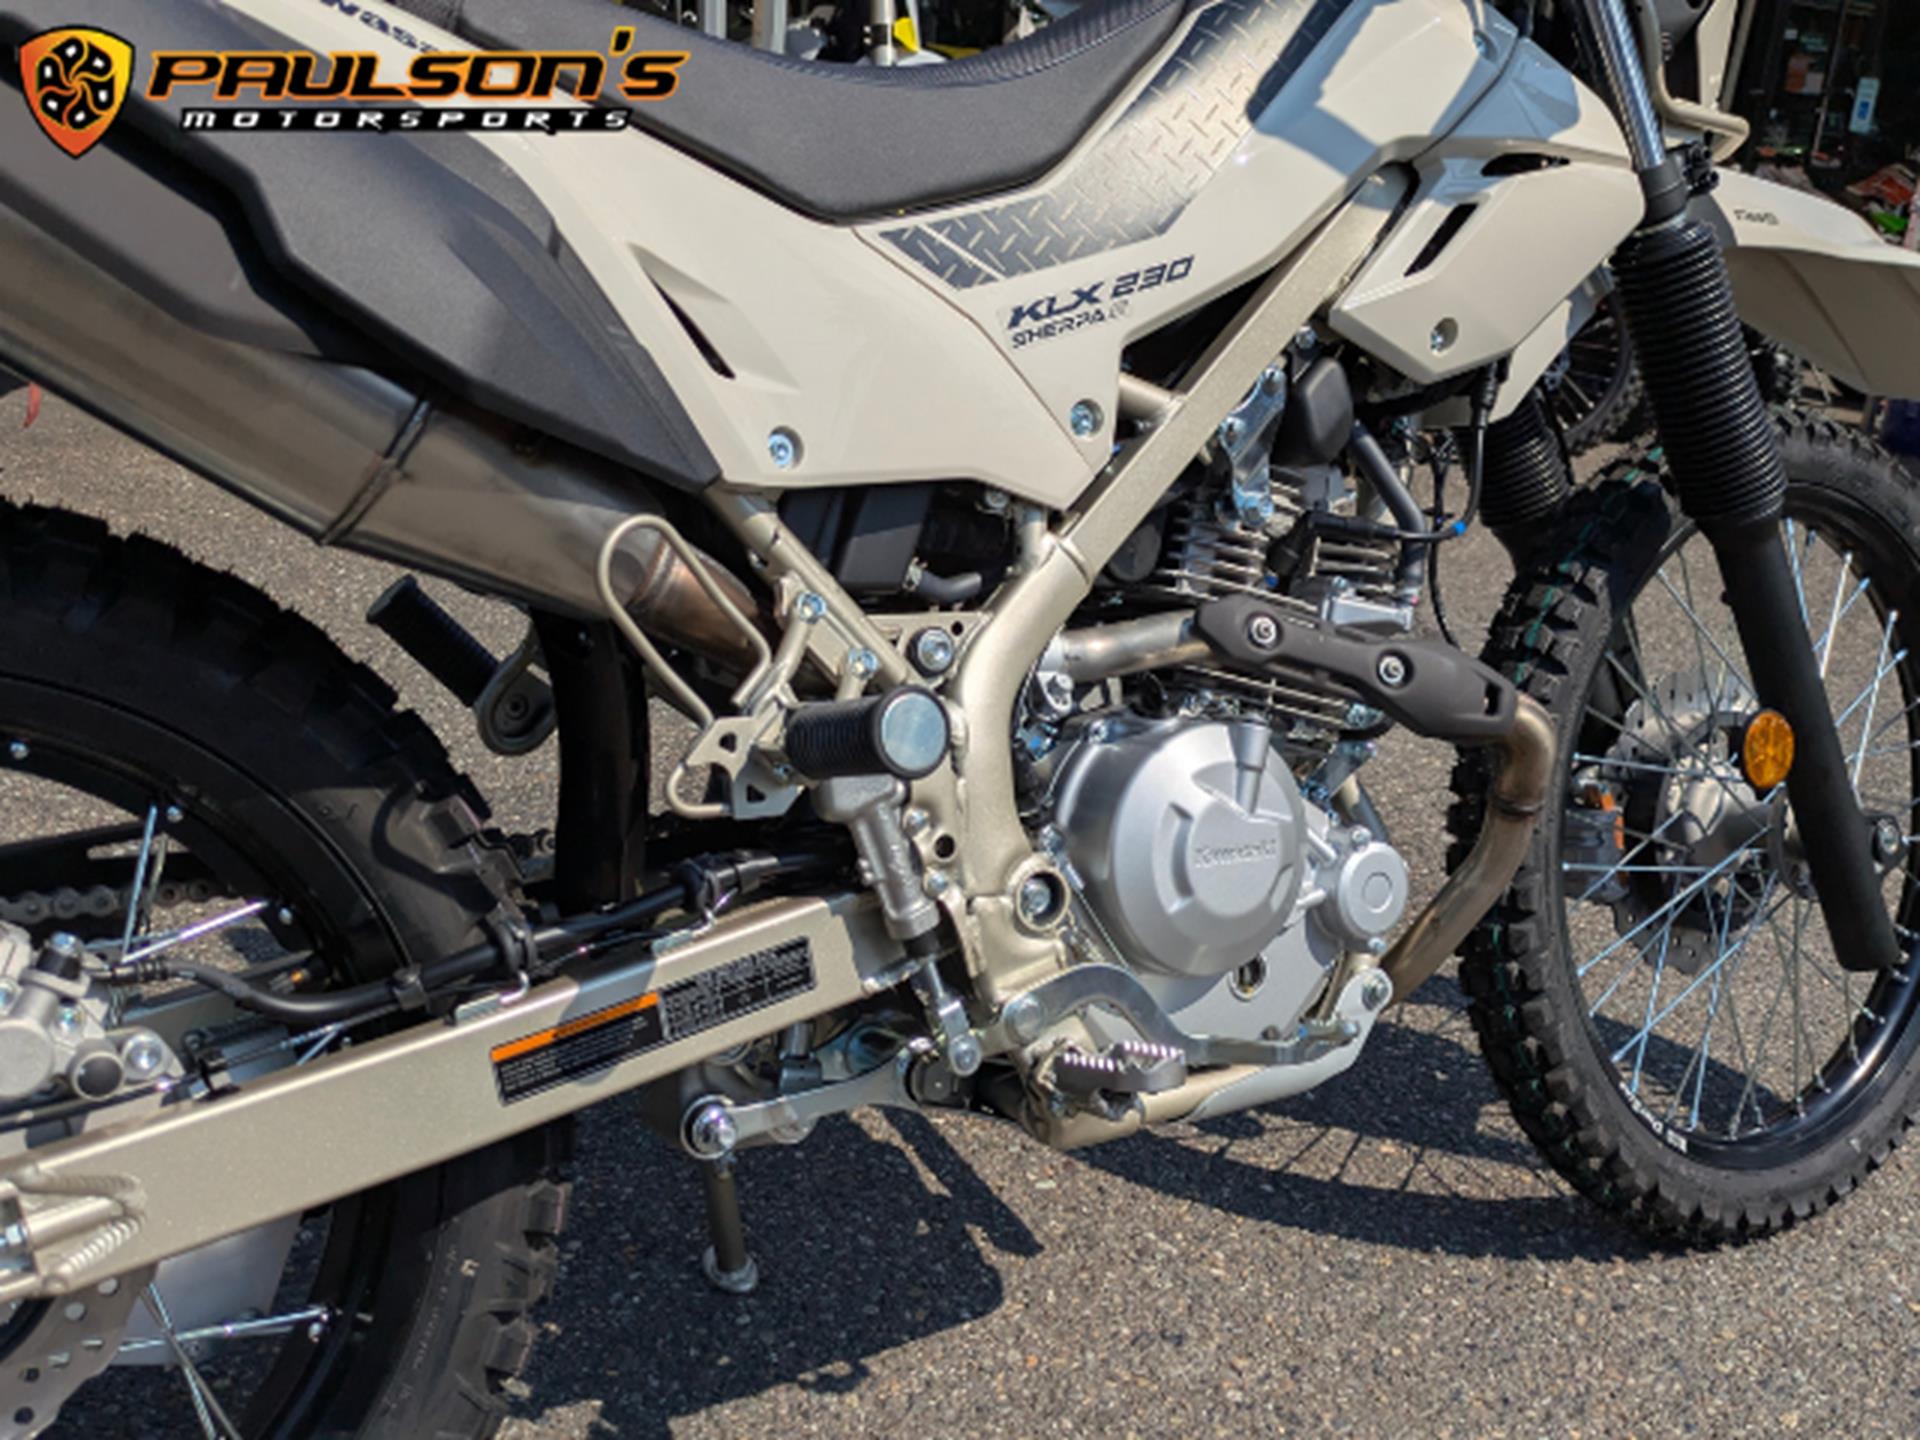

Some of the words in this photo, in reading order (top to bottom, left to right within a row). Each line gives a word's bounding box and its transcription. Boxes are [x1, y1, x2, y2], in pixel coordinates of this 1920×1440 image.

[1007, 280, 1105, 330] KLX
[1110, 255, 1195, 299] 230
[1012, 307, 1106, 349] SHERPA
